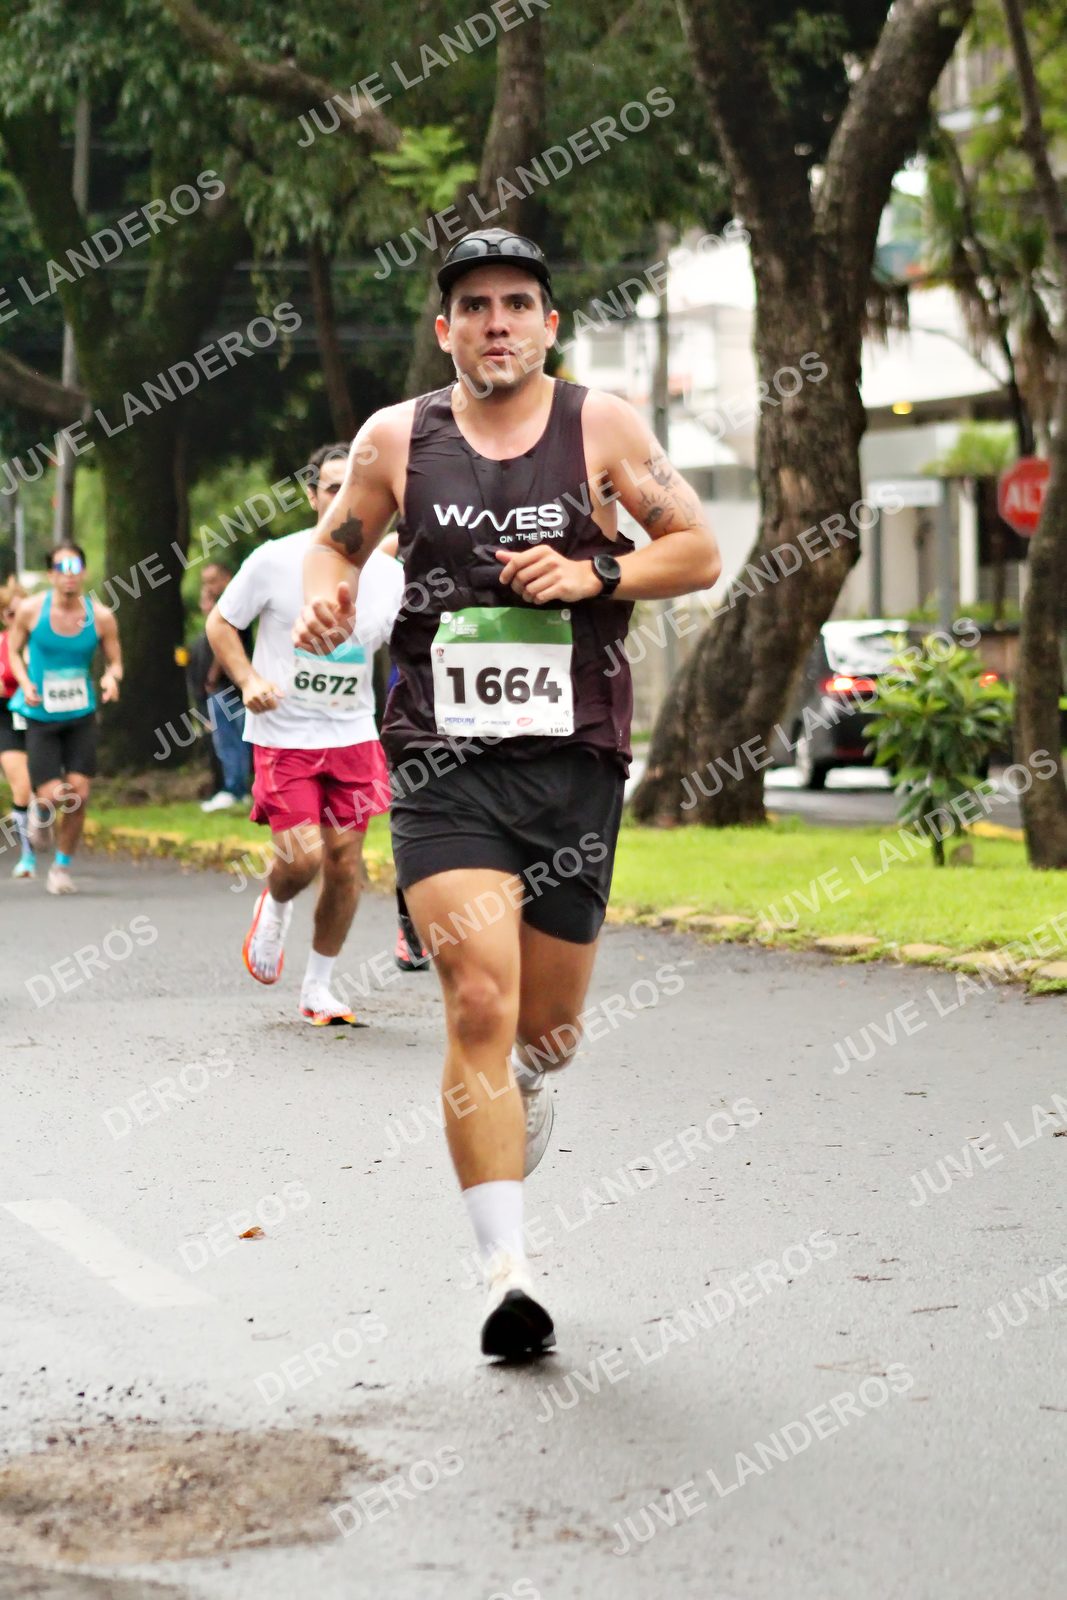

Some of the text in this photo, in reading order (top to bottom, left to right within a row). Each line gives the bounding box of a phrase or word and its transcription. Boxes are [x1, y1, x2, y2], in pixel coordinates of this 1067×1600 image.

[499, 530, 564, 544] ON THE RUN
[294, 671, 358, 695] 6672
[446, 667, 562, 705] 1664
